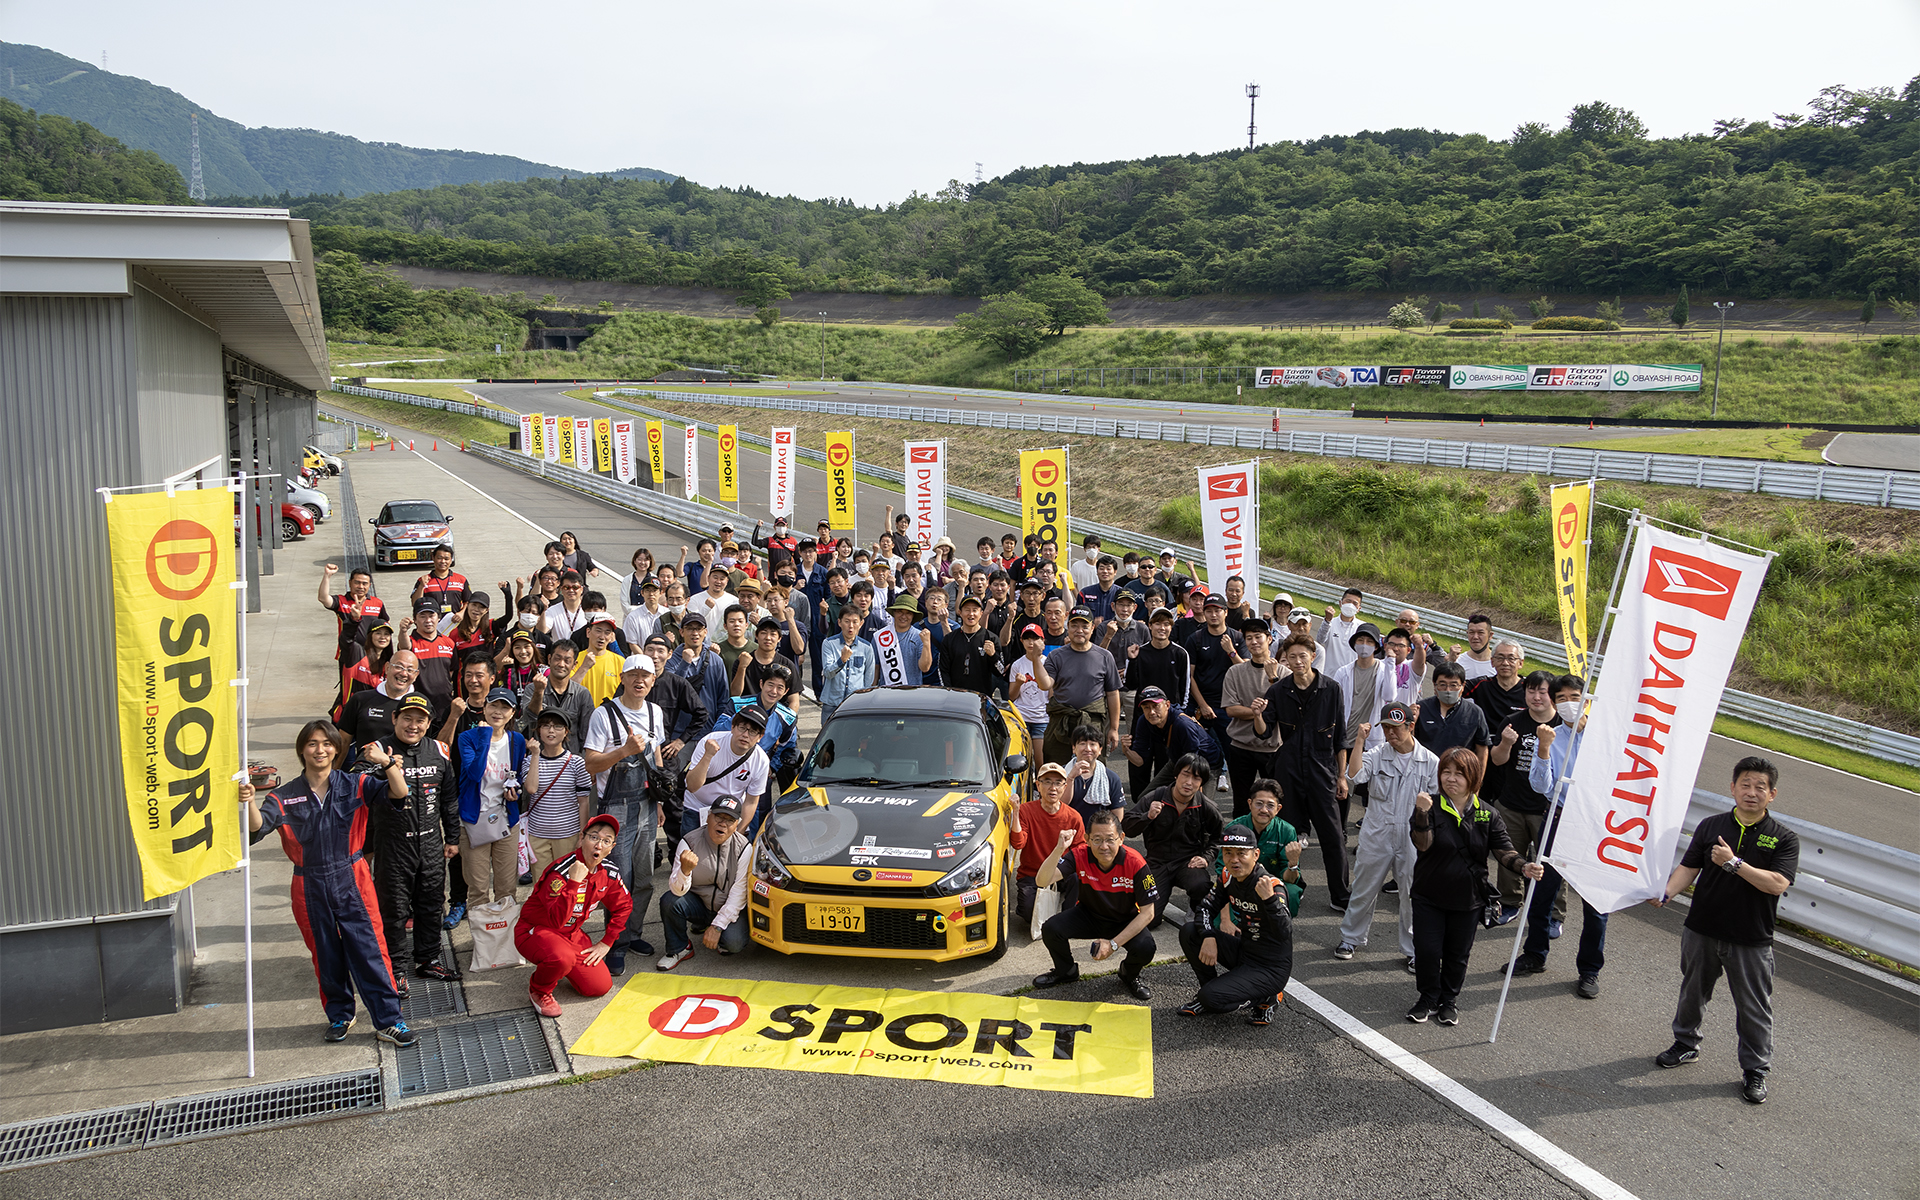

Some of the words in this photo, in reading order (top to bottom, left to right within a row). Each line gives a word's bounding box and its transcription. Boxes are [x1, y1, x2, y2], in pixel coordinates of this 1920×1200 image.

[1260, 375, 1282, 384] GR
[1386, 375, 1411, 384] GR
[1532, 375, 1565, 385] GR
[1566, 380, 1600, 388] Racing
[1632, 374, 1673, 382] OBAYASHI
[1674, 374, 1699, 382] ROAD
[534, 425, 542, 451] SPORT
[563, 430, 572, 459] SPORT
[651, 444, 661, 473] SPORT
[723, 453, 733, 489] SPORT
[833, 468, 847, 514] SPORT
[1036, 491, 1058, 543] SPO
[143, 661, 160, 830] www.Dsport-web.com
[159, 613, 214, 855] SPORT
[1597, 621, 1698, 873] DAIHATSU
[405, 766, 438, 776] SPORT
[801, 843, 842, 863] D-SPORT
[850, 856, 880, 866] SPK
[963, 895, 977, 904] PRO
[821, 915, 861, 930] 19-07
[756, 1004, 1092, 1061] SPORT
[802, 1046, 1033, 1072] www.Dsport-web.com
